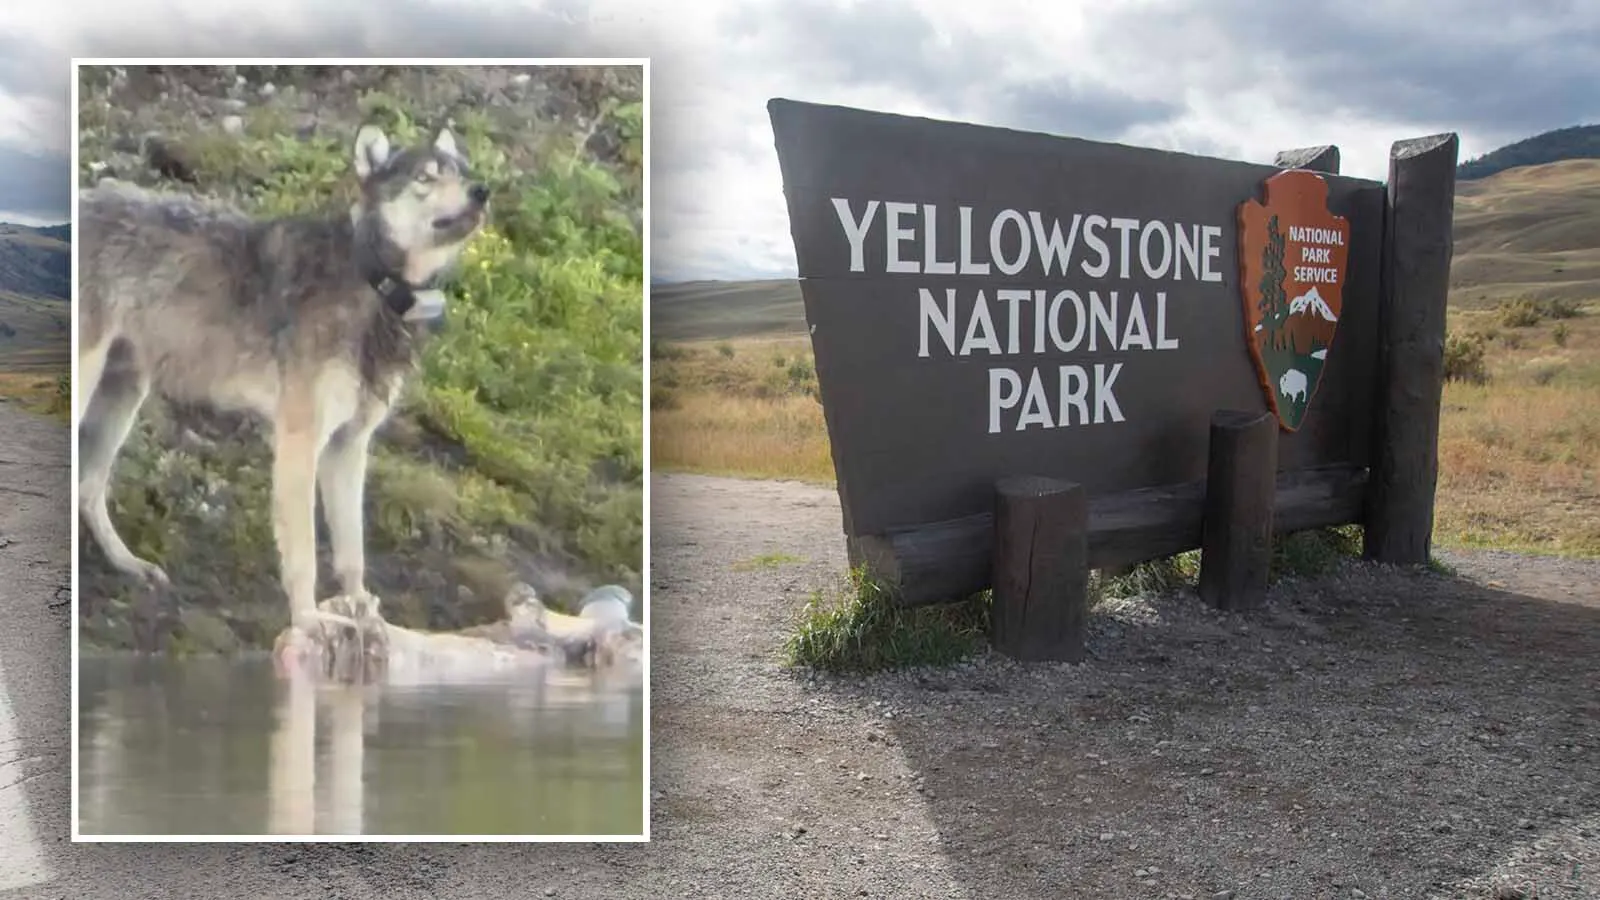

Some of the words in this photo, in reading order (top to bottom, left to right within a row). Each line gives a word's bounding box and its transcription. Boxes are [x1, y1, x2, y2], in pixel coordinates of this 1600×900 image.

[830, 197, 1223, 282] YELLOWSTONE
[1289, 225, 1345, 246] NATIONAL
[1301, 246, 1330, 264] PARK
[1293, 265, 1338, 284] SERVICE
[918, 287, 1179, 357] NATIONAL
[988, 362, 1126, 434] PARK
